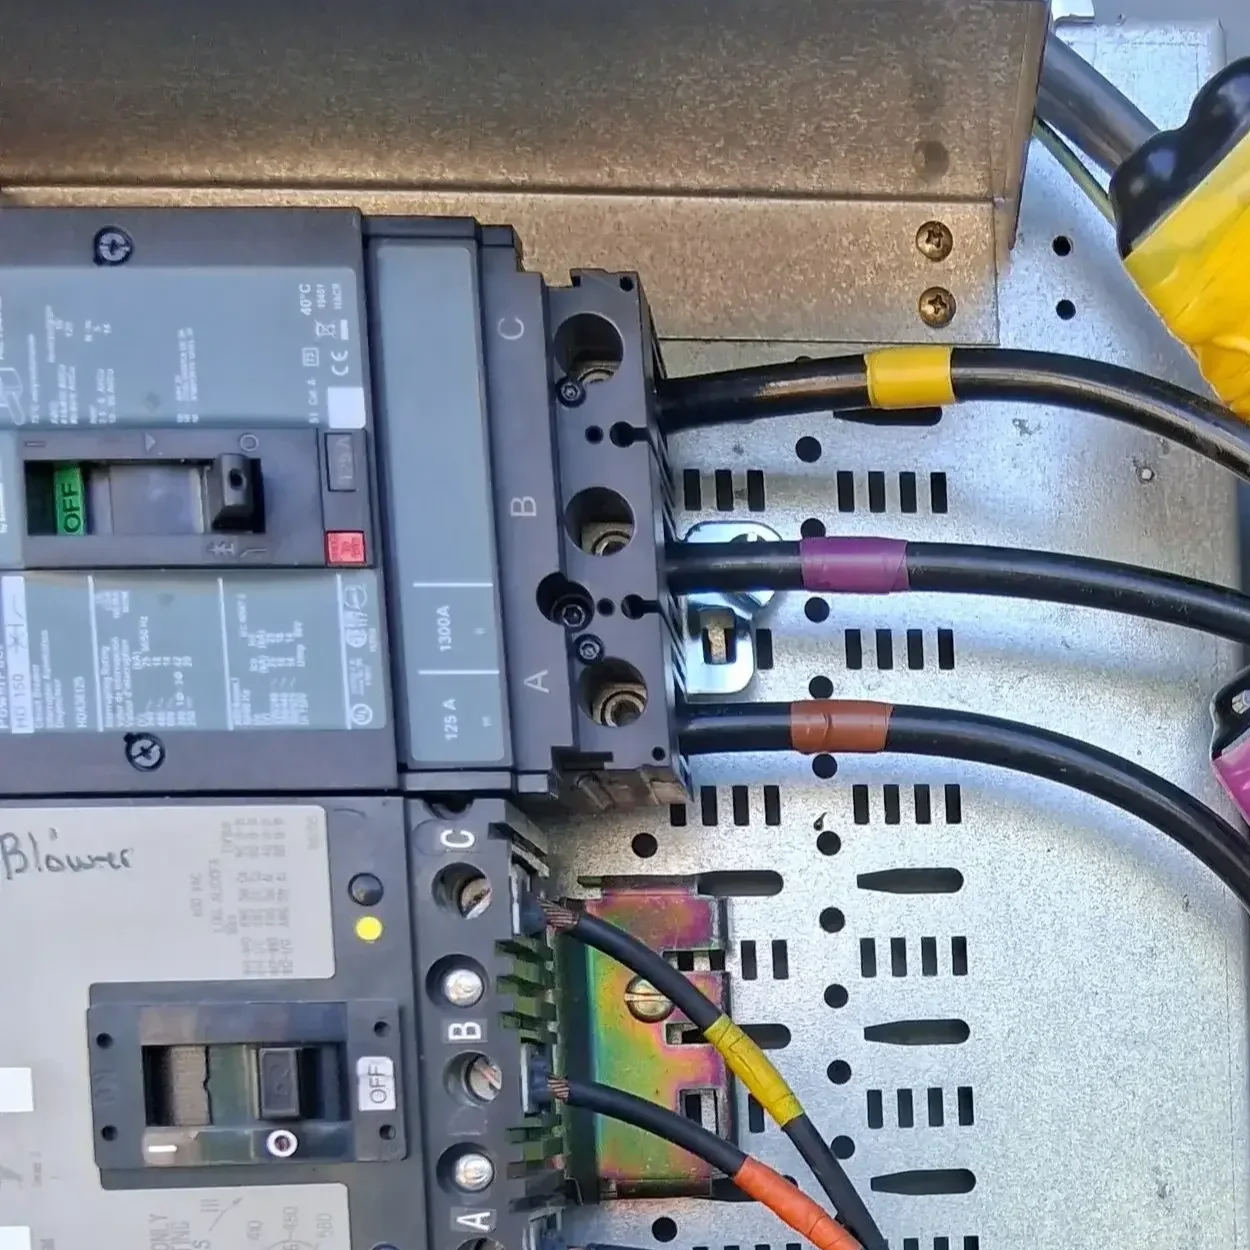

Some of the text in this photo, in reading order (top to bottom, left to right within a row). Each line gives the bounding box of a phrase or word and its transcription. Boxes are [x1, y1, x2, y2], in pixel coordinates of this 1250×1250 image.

[497, 317, 524, 340] C
[61, 482, 81, 533] OFF
[510, 496, 537, 518] B
[437, 605, 452, 651] 1300A
[524, 670, 549, 693] A
[443, 714, 457, 741] 125
[440, 829, 475, 849] C
[448, 1022, 482, 1040] B
[368, 1064, 387, 1104] OFF
[456, 1211, 490, 1232] A
